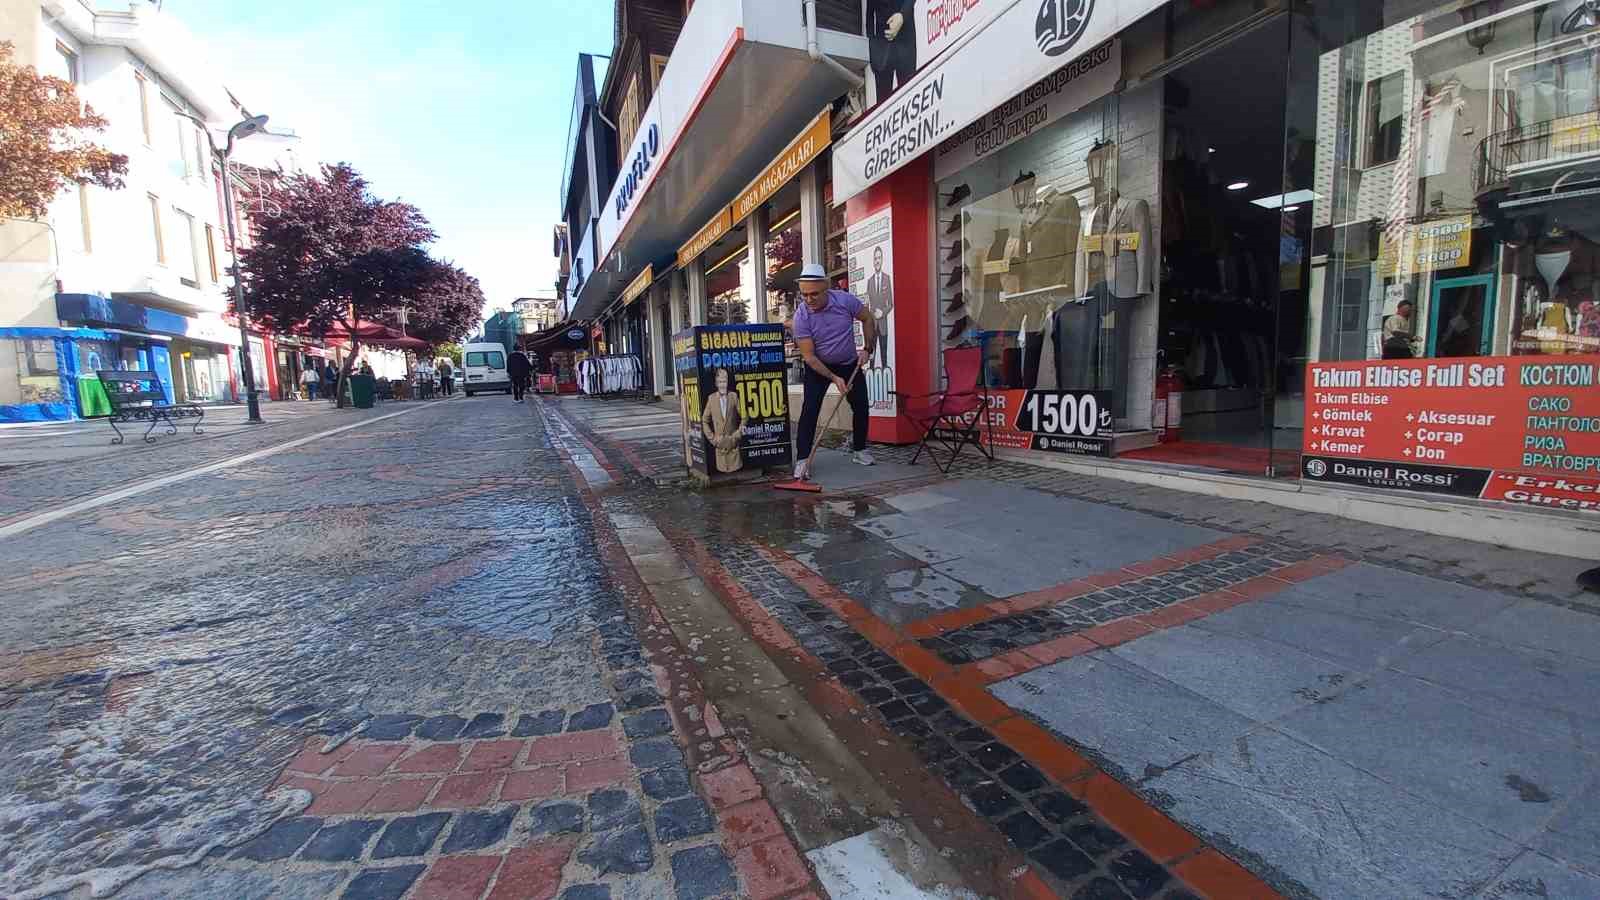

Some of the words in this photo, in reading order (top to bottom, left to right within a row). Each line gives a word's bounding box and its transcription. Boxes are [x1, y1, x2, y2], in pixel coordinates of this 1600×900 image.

[865, 73, 944, 155] ERKEKSEN
[1313, 368, 1361, 387] Takım
[1366, 366, 1422, 387] Elbise
[1426, 364, 1464, 387] Full
[1468, 364, 1504, 387] Set
[1521, 365, 1592, 385] КОСТЮМ
[736, 379, 784, 418] 1500
[1315, 393, 1348, 404] Takım
[1351, 393, 1388, 404] Elbise
[1528, 397, 1570, 411] САКО
[1322, 408, 1372, 421] Gömlek
[1418, 411, 1495, 426] Aksesuar
[1321, 424, 1365, 437] Kravat
[1417, 428, 1463, 445] Çorap
[1320, 439, 1365, 453] Kemer
[1524, 436, 1565, 450] РИЗА
[1416, 445, 1445, 459] Don
[1333, 463, 1389, 479] Daniel
[1395, 468, 1453, 486] Rossi
